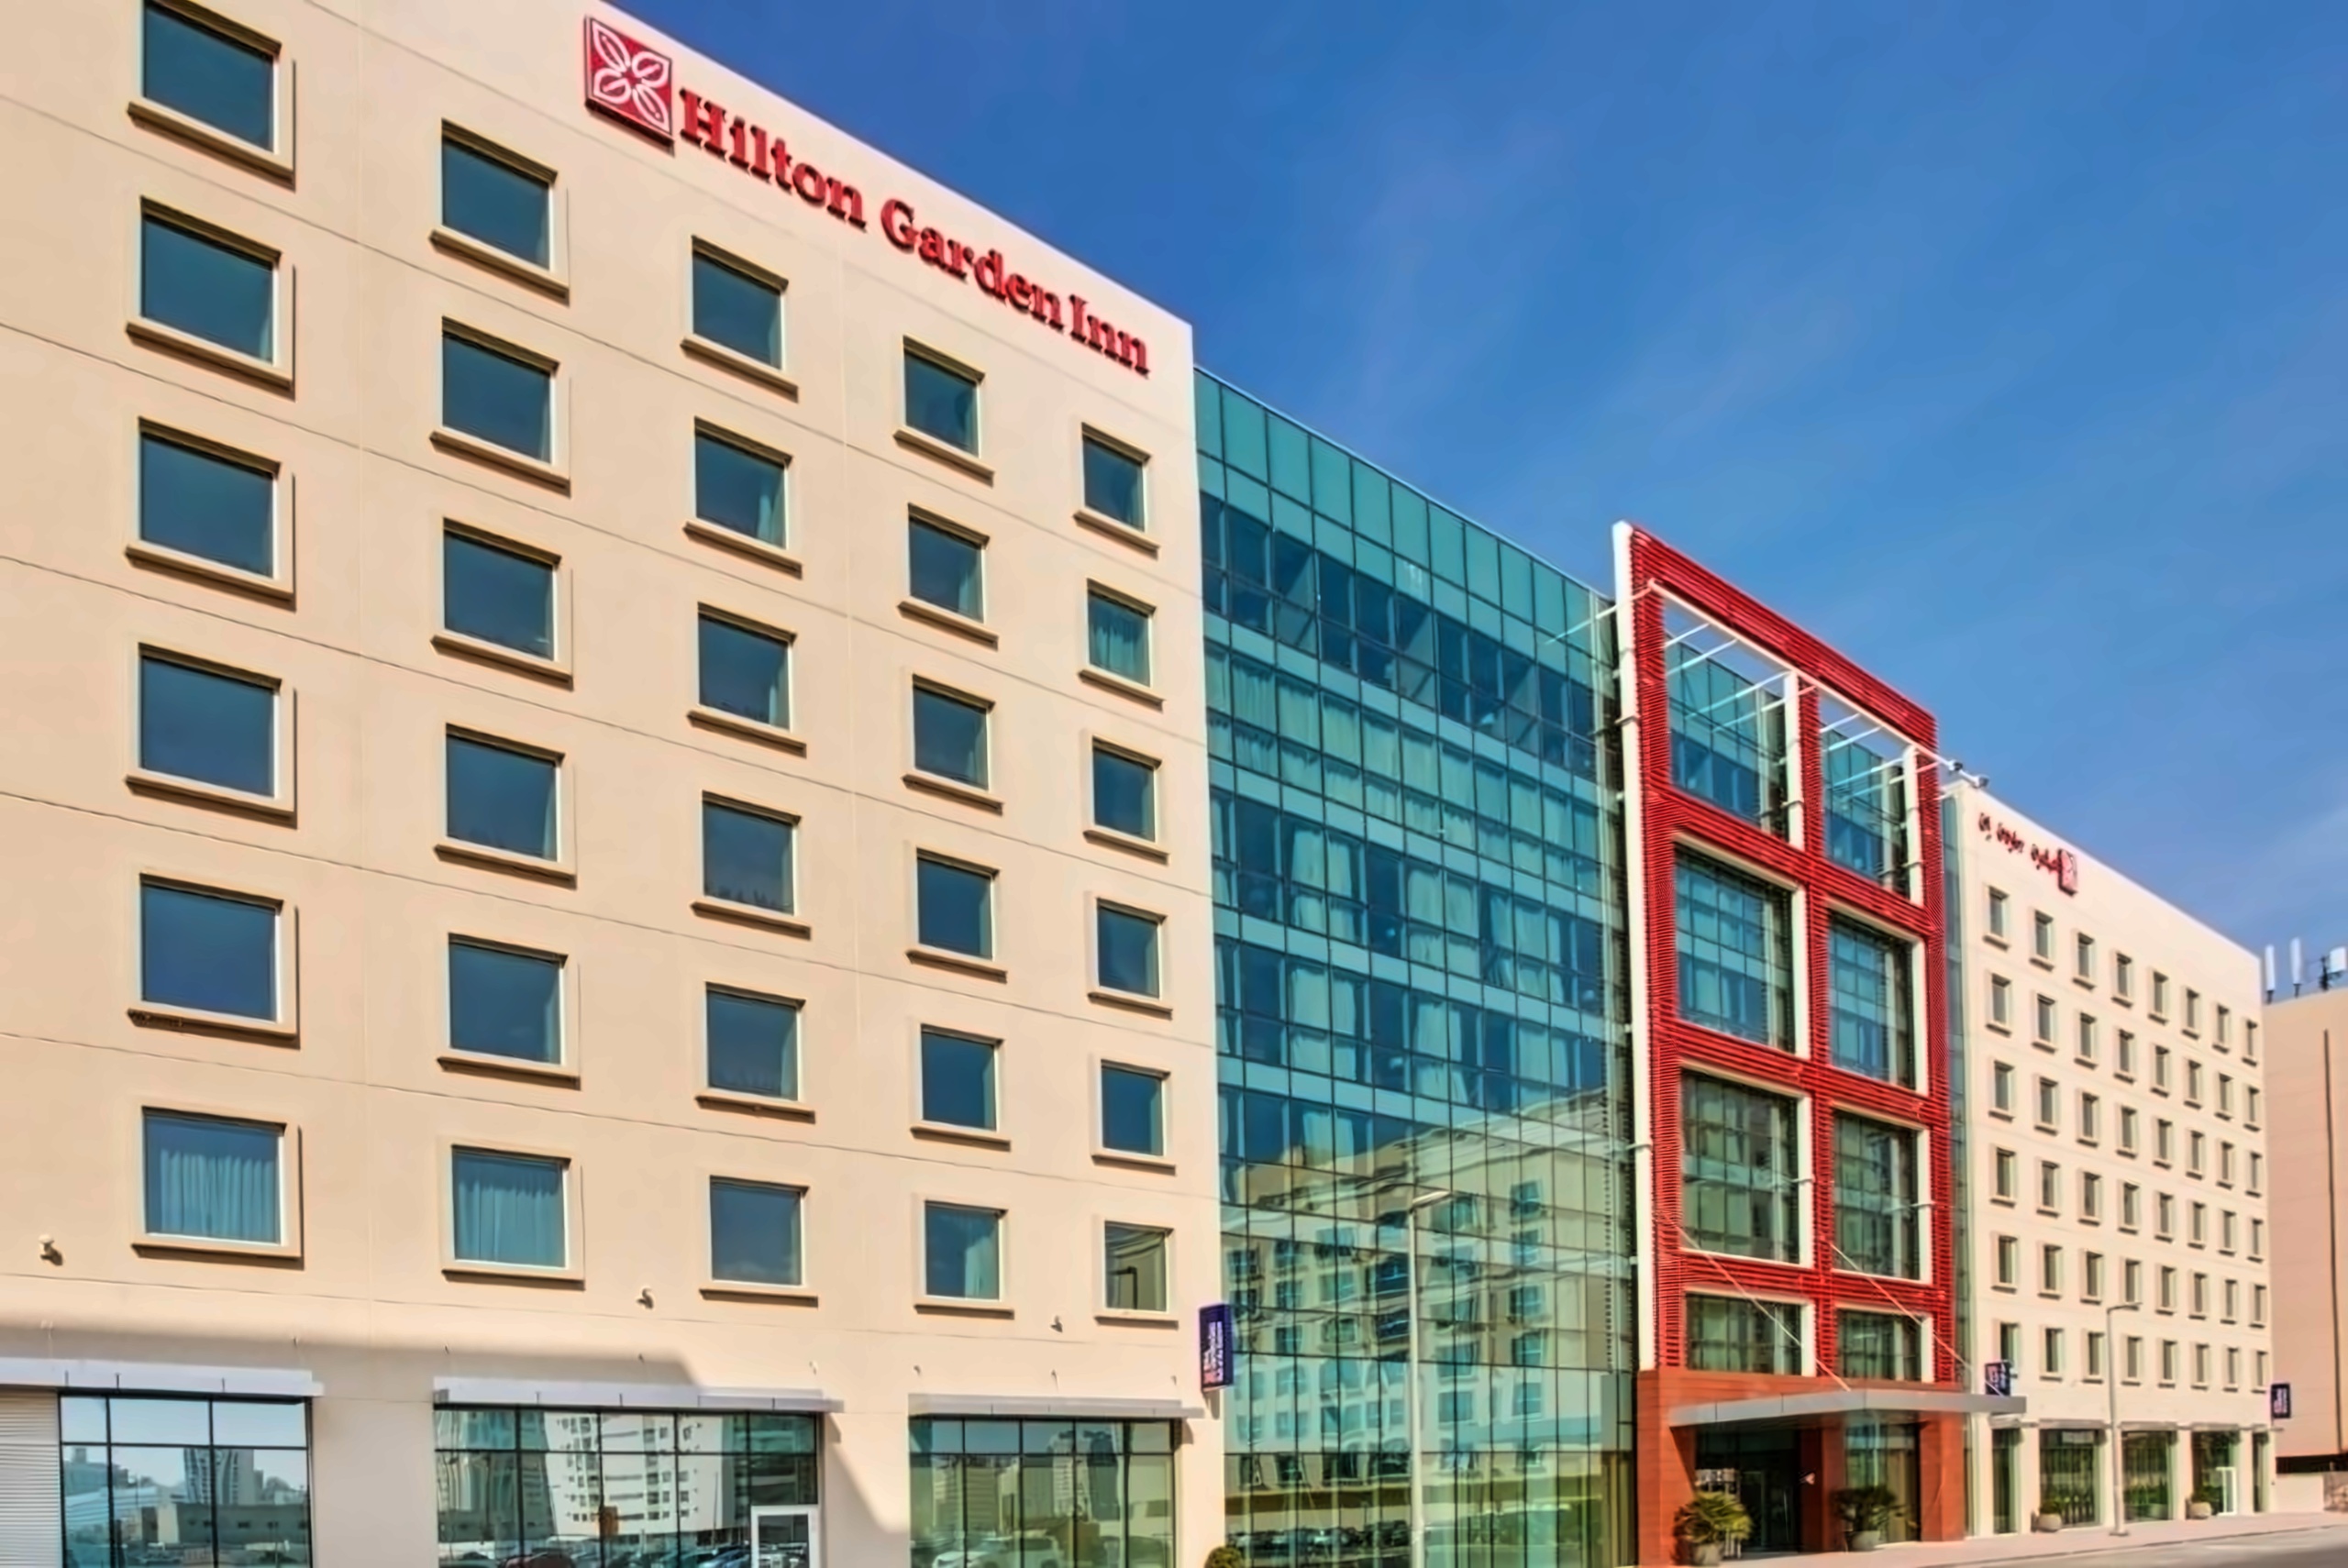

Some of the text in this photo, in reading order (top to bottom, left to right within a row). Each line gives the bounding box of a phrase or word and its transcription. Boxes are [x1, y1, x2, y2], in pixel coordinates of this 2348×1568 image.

[679, 88, 1149, 377] Hilton Garden Inn
